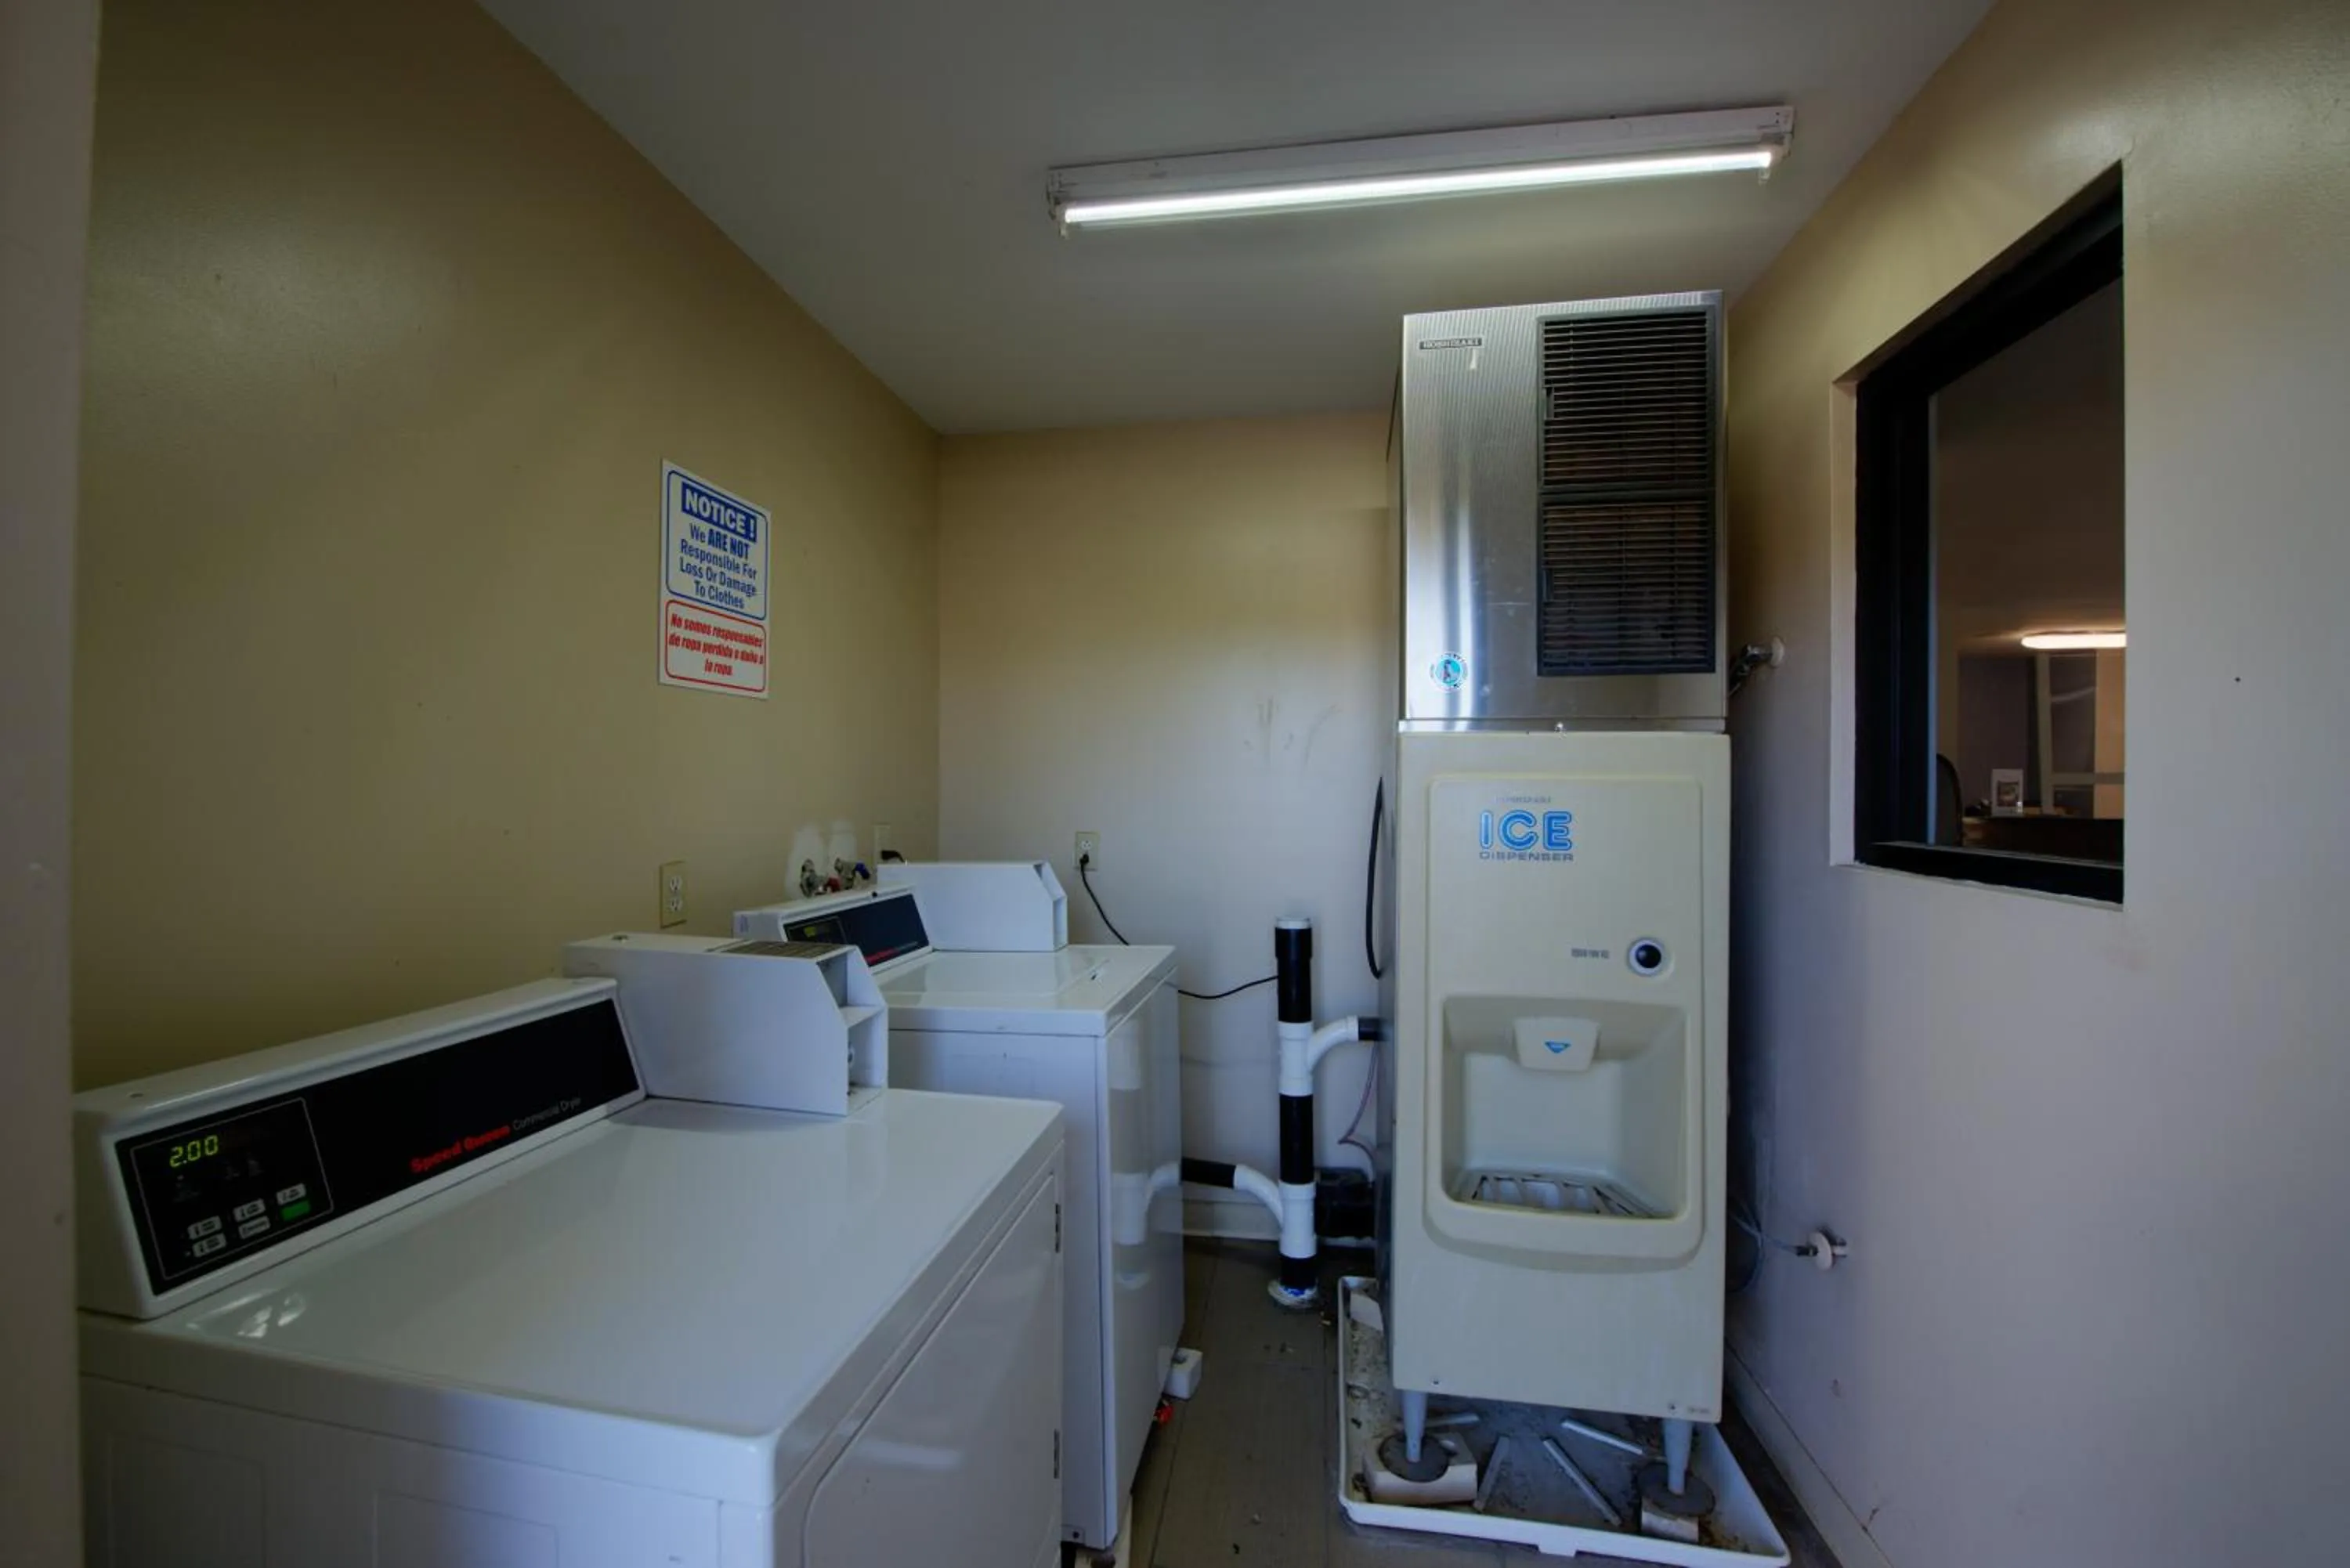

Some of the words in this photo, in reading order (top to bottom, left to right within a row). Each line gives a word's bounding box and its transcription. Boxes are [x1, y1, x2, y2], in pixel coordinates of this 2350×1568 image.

[689, 522, 706, 543] We
[707, 529, 728, 551] ARE
[729, 537, 750, 561] NOT
[681, 538, 740, 574] Responsible
[743, 562, 757, 580] For
[679, 556, 704, 578] Loss
[706, 566, 718, 583] Or
[719, 572, 756, 598] Damage
[694, 580, 706, 597] To
[707, 585, 744, 609] Clothes
[671, 613, 683, 628] No
[1479, 809, 1572, 851] ICE
[1479, 851, 1574, 862] DISPENSER
[169, 1134, 219, 1168] 2.00
[409, 1141, 462, 1173] Speed
